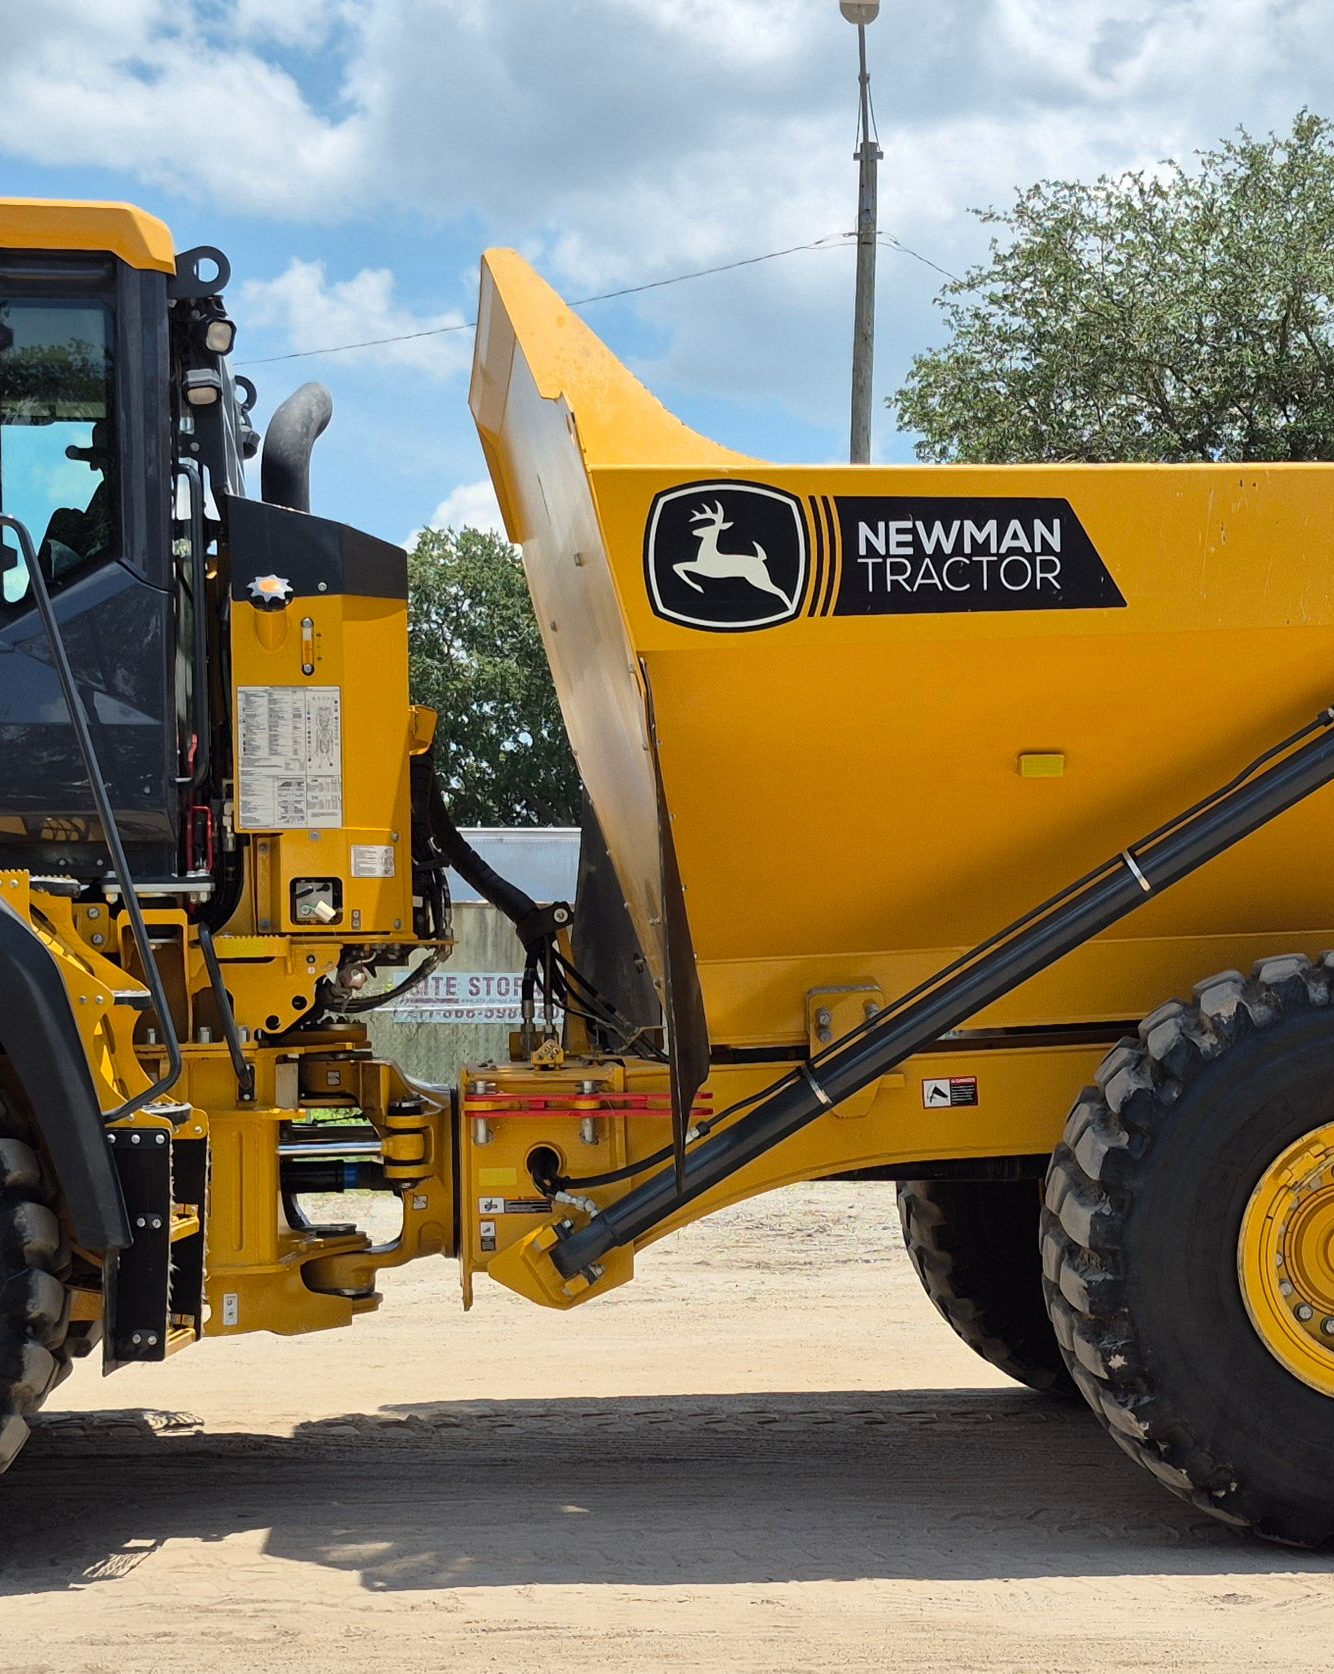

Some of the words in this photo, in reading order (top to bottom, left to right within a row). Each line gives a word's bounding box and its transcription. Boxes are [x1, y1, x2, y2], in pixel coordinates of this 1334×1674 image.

[858, 519, 1061, 555] NEWMAN
[857, 556, 1061, 592] TRACTOR
[410, 976, 457, 996] ITE
